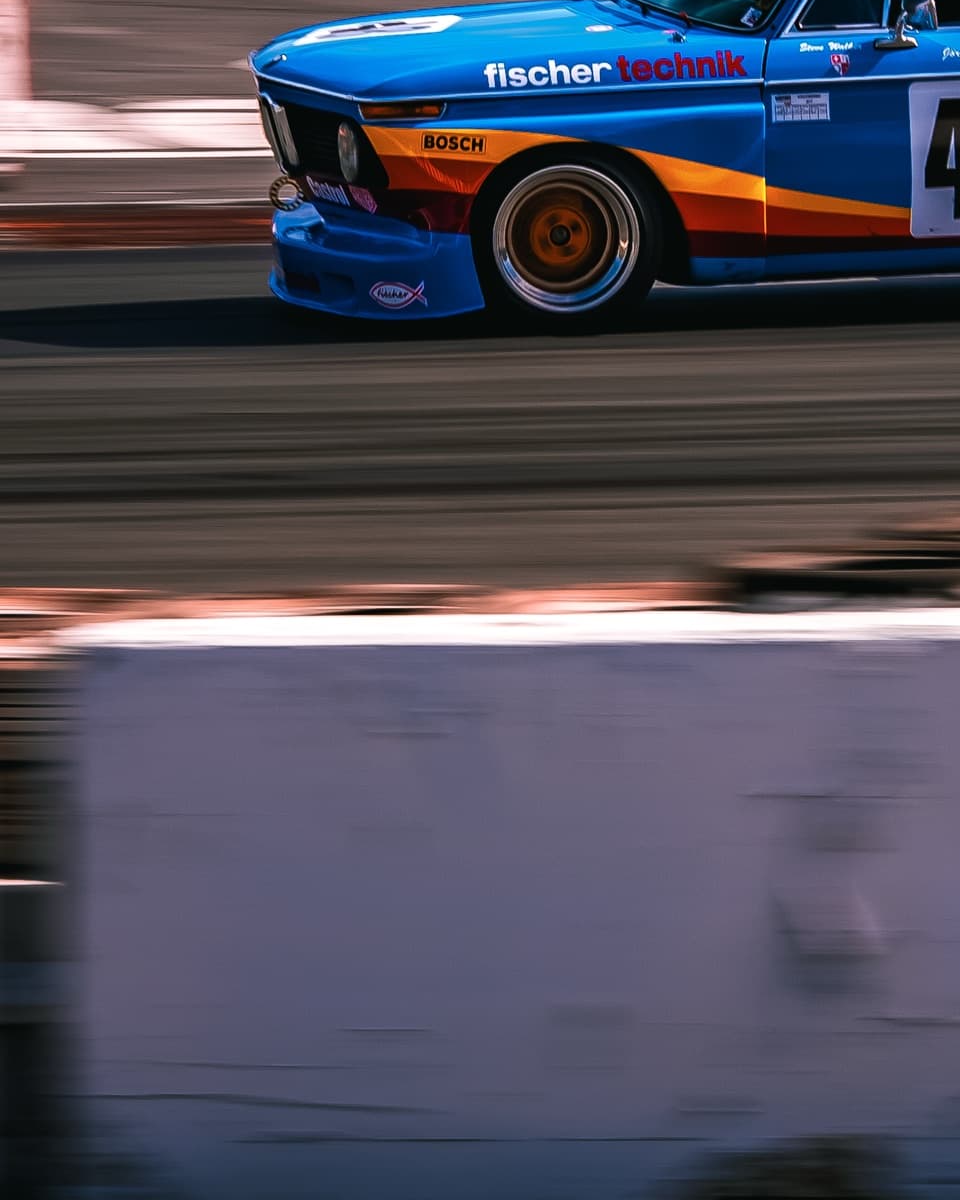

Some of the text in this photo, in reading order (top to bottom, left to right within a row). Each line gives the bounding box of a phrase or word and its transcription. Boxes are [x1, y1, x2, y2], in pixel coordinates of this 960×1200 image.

[484, 50, 748, 89] fischer technik
[423, 134, 484, 153] BOSCH
